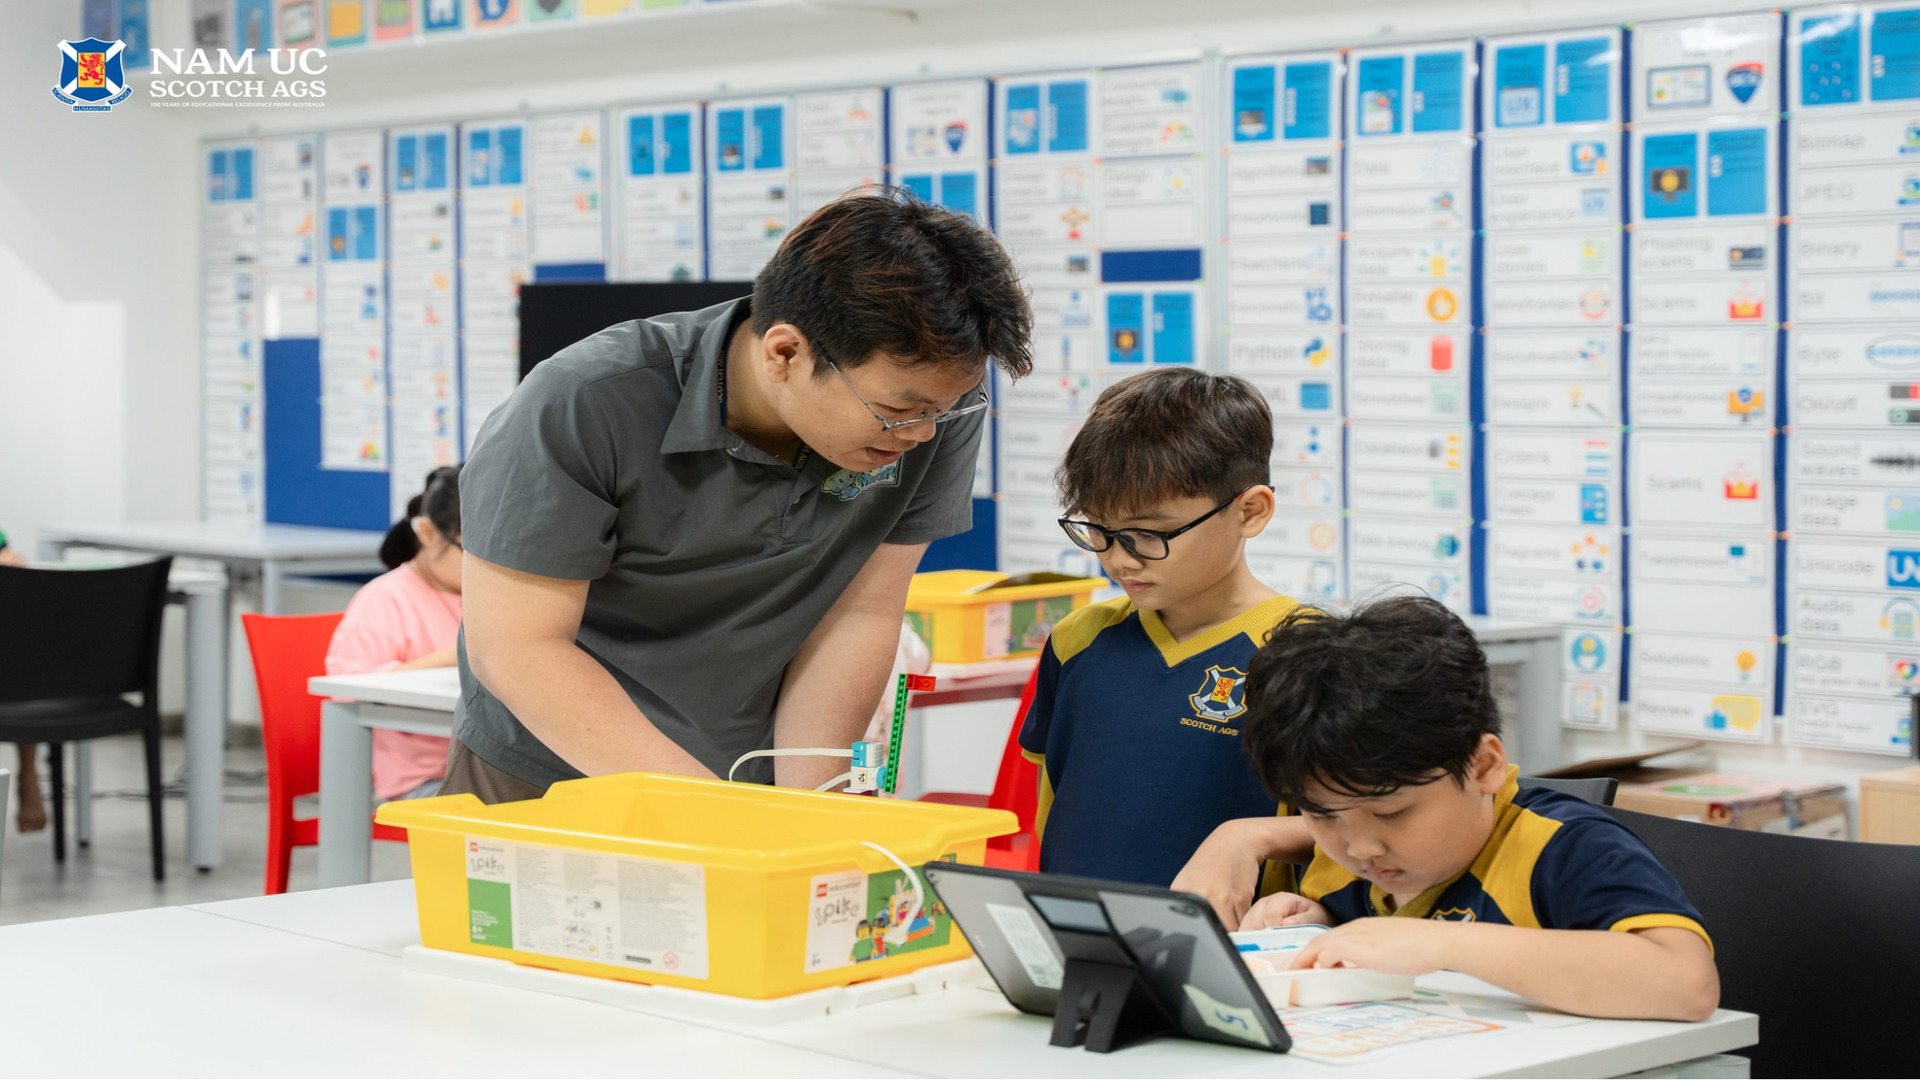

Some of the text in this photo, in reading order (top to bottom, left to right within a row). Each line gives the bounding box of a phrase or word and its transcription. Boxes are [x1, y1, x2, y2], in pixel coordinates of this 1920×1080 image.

[1798, 133, 1866, 152] Bitmap
[1802, 182, 1855, 202] JPEG
[1799, 239, 1861, 260] Binary
[1640, 295, 1697, 310] Scams
[1799, 289, 1825, 306] Bit
[1234, 340, 1296, 363] Python
[1799, 345, 1841, 366] Byte
[1801, 441, 1862, 459] Sound
[1801, 464, 1861, 478] waves
[1646, 473, 1704, 492] Scams
[1801, 493, 1859, 511] Image
[1801, 512, 1841, 527] data
[1796, 555, 1875, 576] Unicode
[1801, 597, 1855, 616] Audio
[1801, 616, 1842, 632] data
[1640, 650, 1711, 668] Solutions
[1798, 653, 1843, 672] RGB
[1637, 700, 1693, 716] Review
[1797, 698, 1839, 716] SVG
[1180, 717, 1239, 737] SCOTCH AGS
